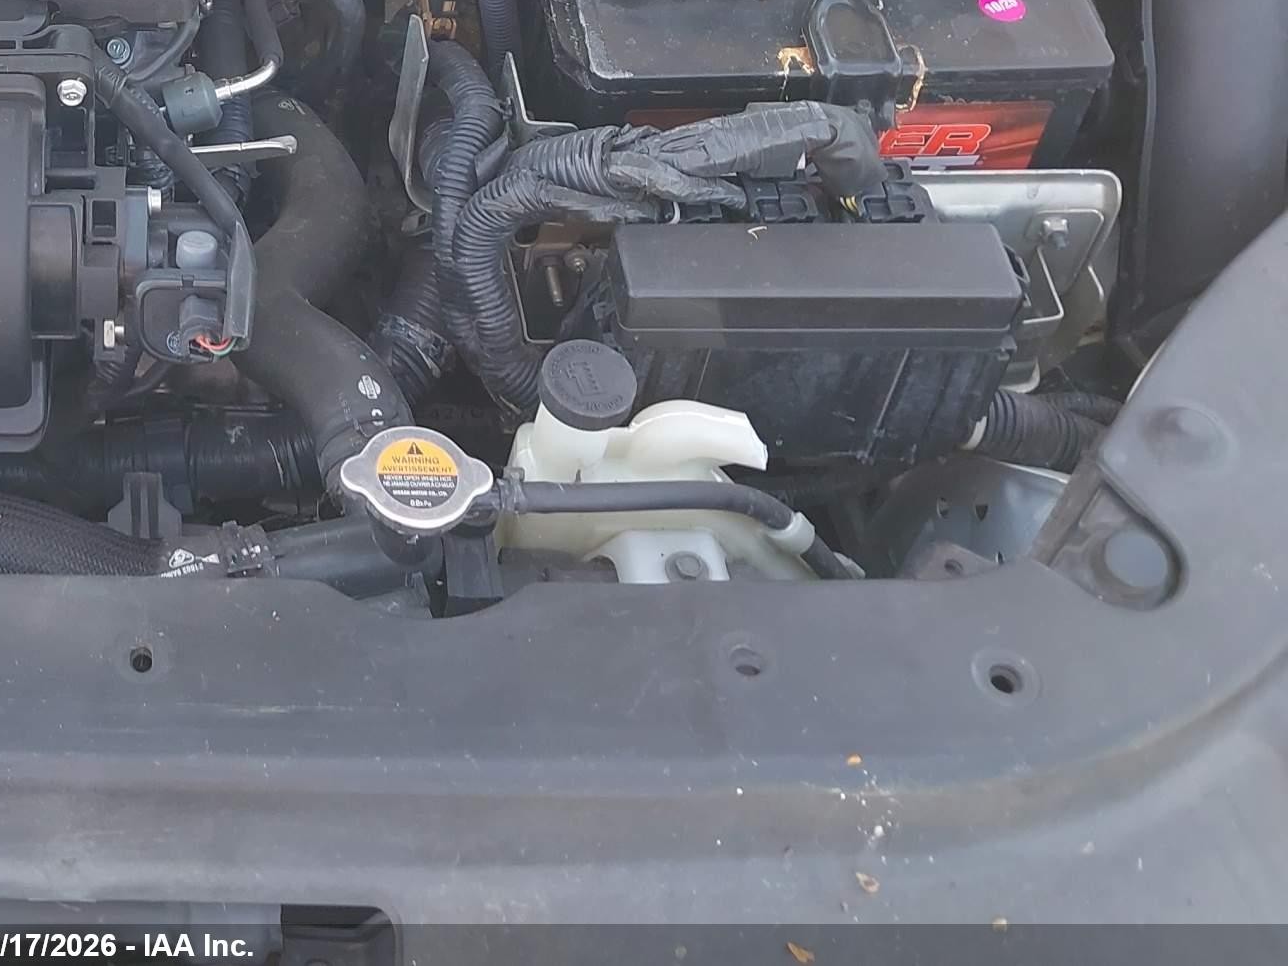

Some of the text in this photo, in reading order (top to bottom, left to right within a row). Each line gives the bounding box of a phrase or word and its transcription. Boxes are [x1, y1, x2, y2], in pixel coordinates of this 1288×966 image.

[879, 124, 992, 156] ER
[391, 456, 440, 465] WARNING
[382, 465, 452, 473] AVERTISSEMENT
